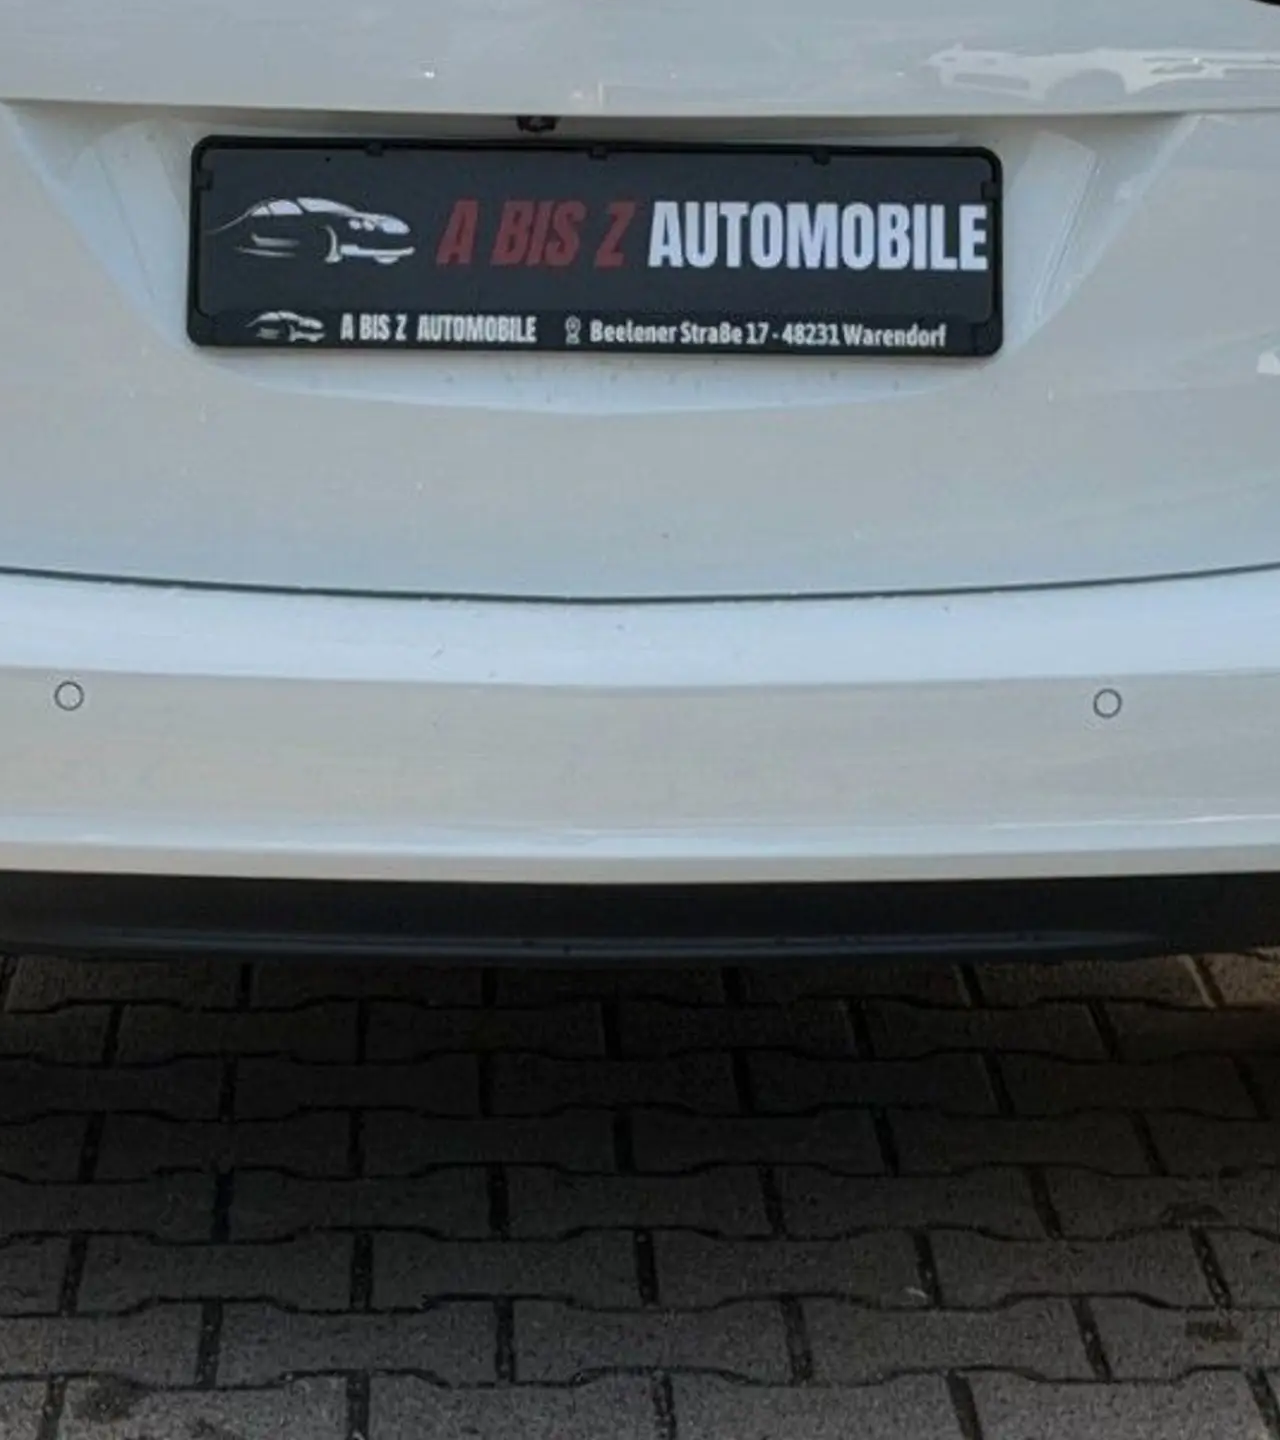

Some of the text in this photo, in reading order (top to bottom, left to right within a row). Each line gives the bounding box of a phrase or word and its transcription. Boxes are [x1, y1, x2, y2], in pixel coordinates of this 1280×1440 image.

[435, 200, 989, 270] A BIS Z AUTOMOBILE
[340, 313, 537, 343] A BIS Z AUTOMOBILE
[589, 319, 678, 343] Beelener
[746, 322, 770, 345] 17
[782, 322, 841, 346] 48231
[842, 322, 947, 347] Warendorf
